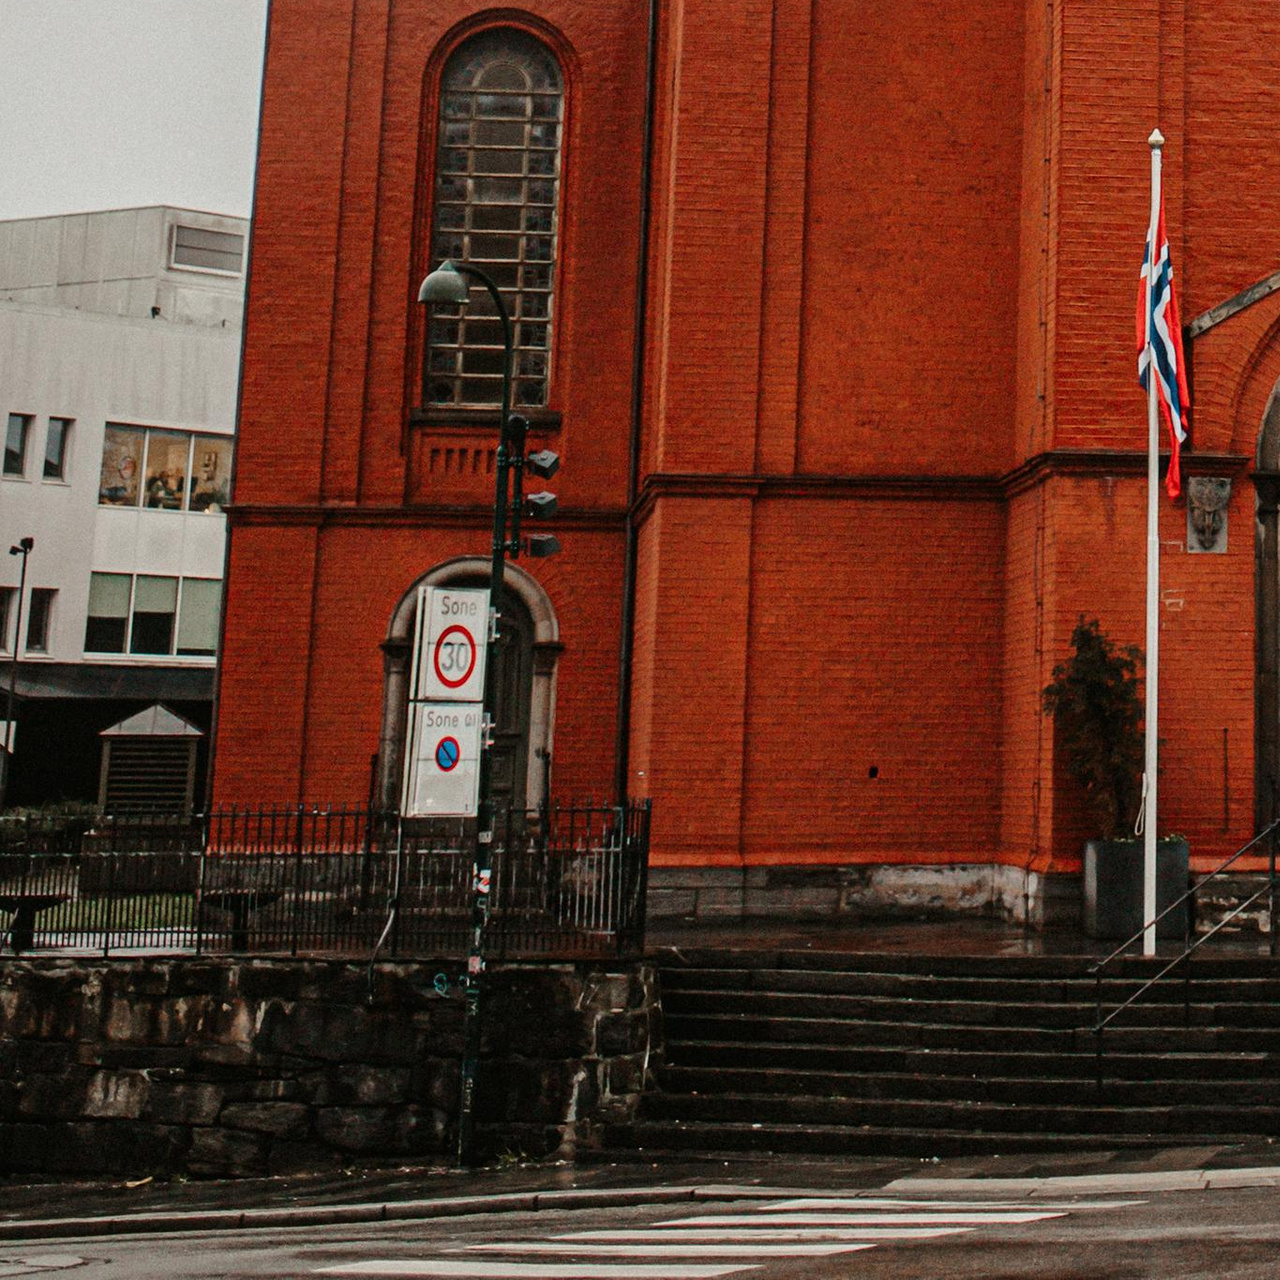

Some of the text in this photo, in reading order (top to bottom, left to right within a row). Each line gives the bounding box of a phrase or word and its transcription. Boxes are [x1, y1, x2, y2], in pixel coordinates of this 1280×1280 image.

[441, 595, 477, 616] Sone
[442, 641, 469, 672] 30
[426, 711, 459, 728] Sone
